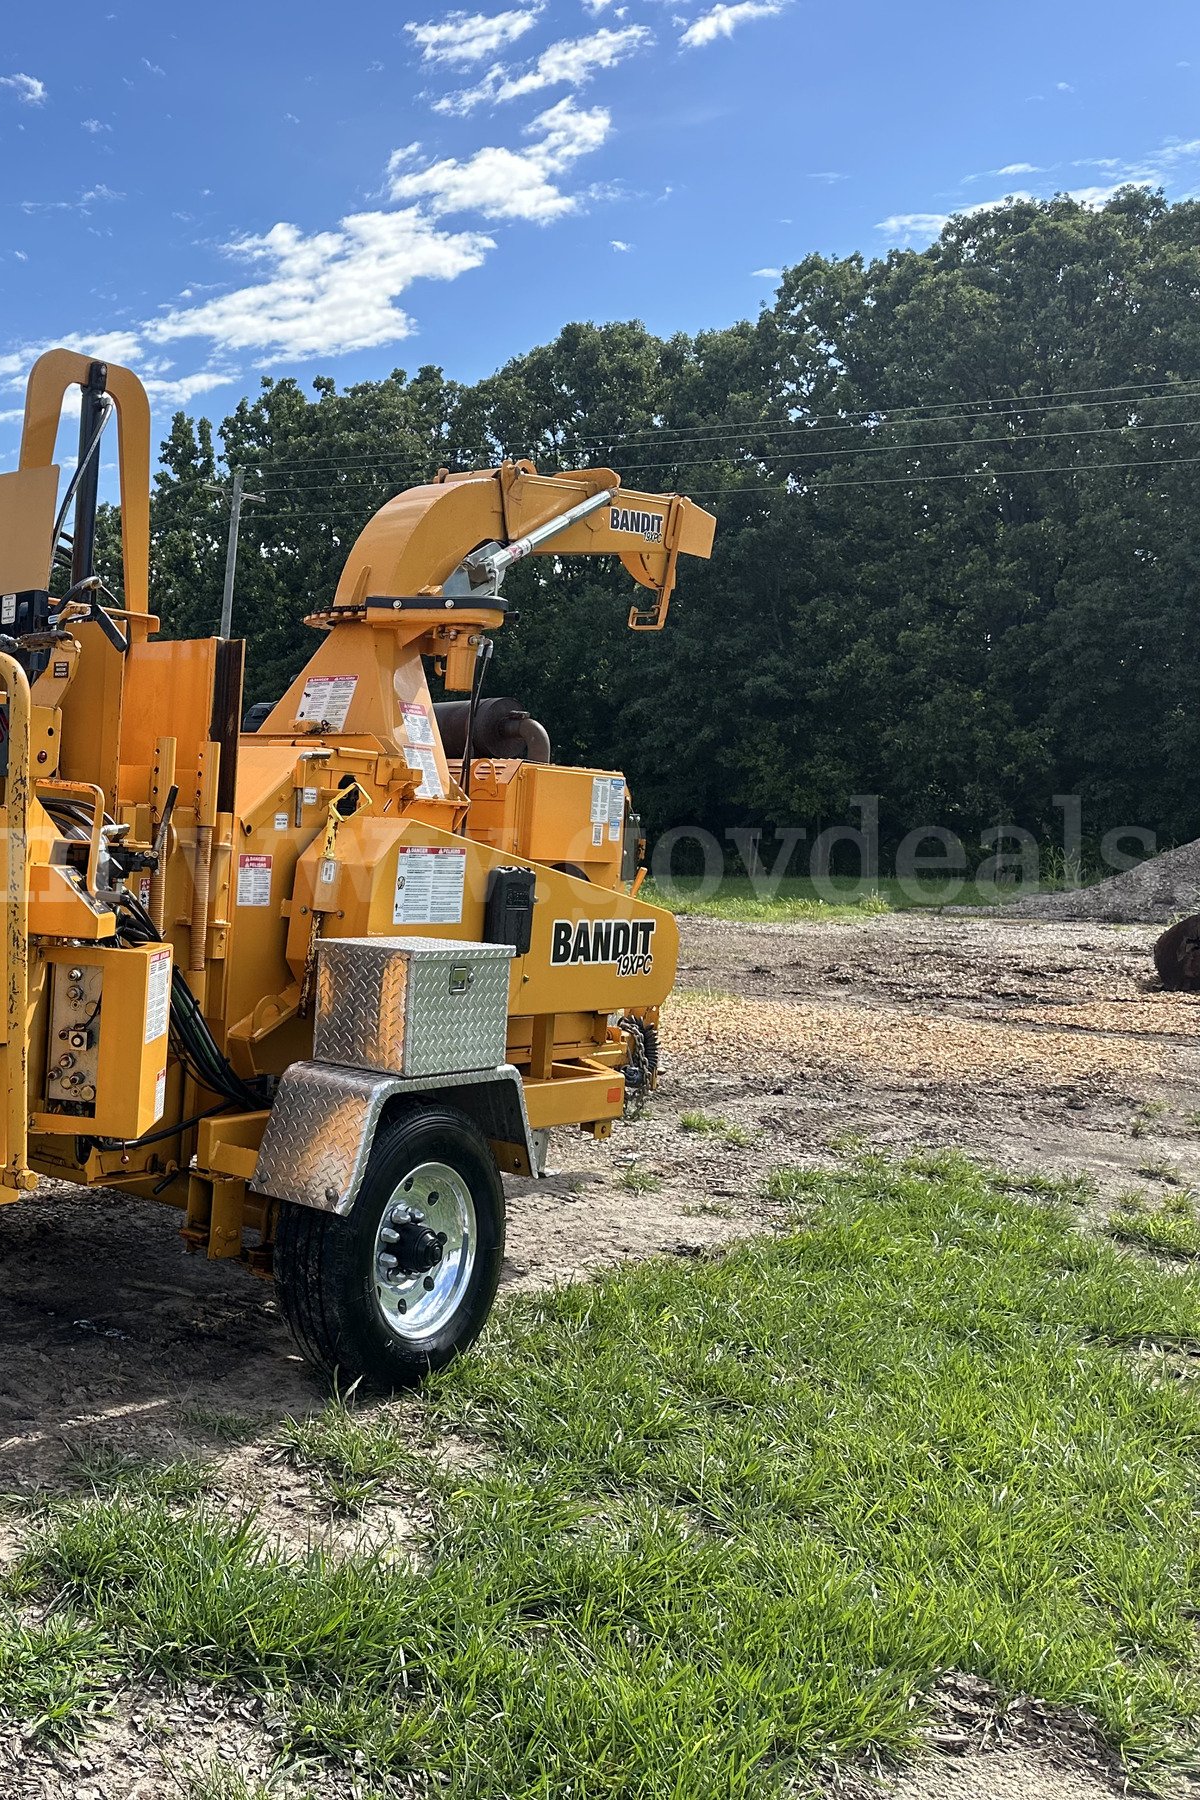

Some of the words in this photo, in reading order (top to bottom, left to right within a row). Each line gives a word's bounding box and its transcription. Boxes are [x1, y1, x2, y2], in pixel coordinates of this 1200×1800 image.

[610, 508, 663, 534] BANDIT
[551, 921, 655, 963] BANDIT
[617, 954, 653, 976] 19XPC
